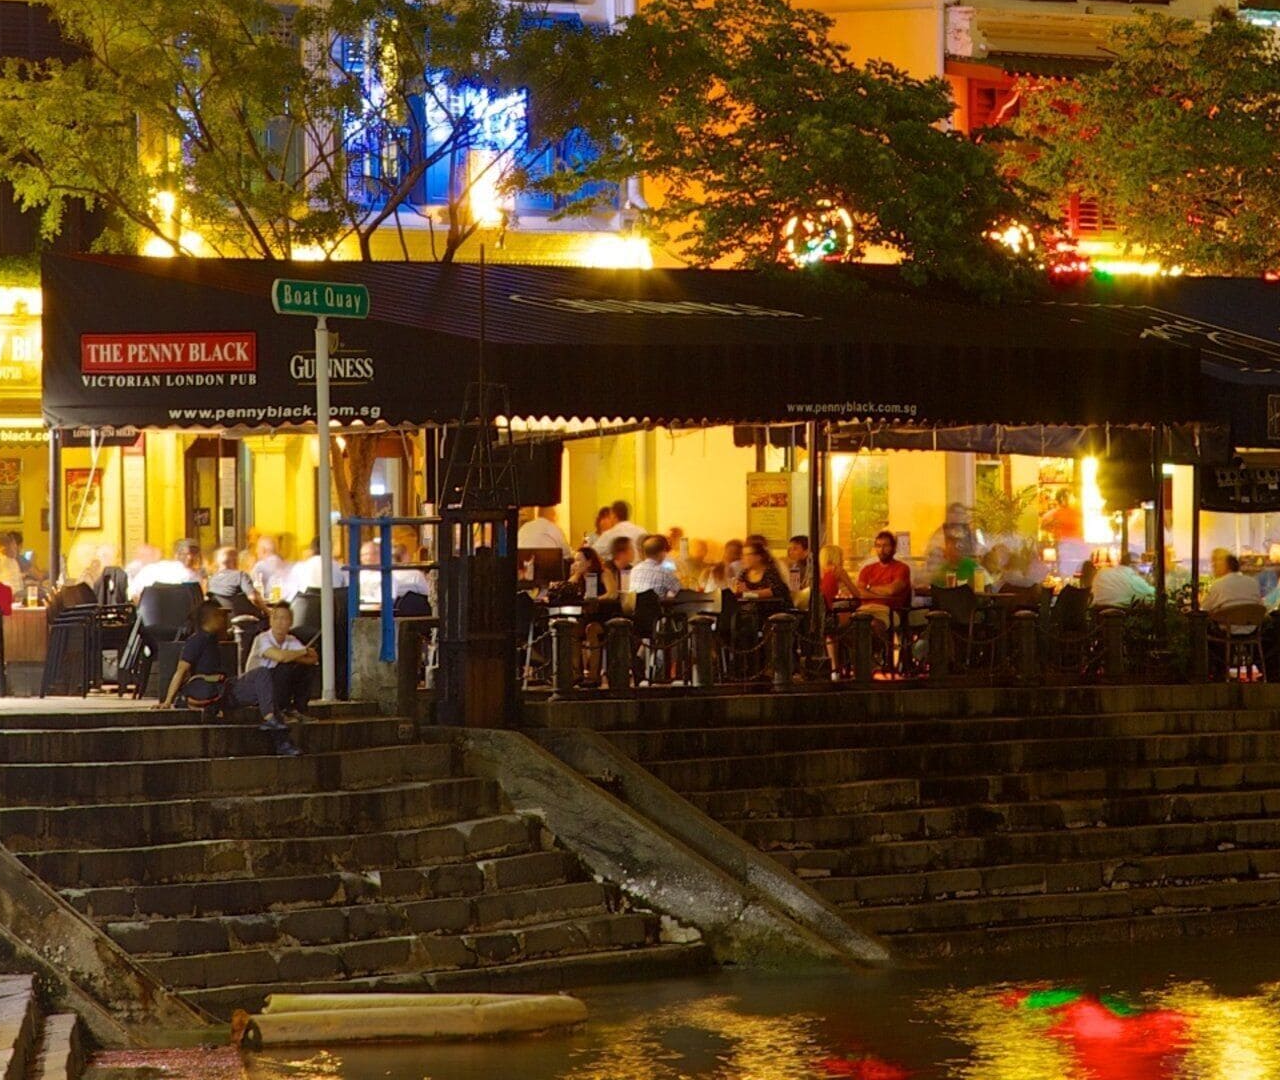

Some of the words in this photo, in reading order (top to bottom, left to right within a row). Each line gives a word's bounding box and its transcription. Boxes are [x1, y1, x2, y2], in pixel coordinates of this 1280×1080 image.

[283, 284, 319, 306] Boat
[324, 286, 361, 313] Quay
[87, 343, 123, 363] THE
[127, 342, 185, 363] PENNY
[188, 341, 249, 362] BLACK
[289, 354, 374, 379] GUNNESS
[81, 375, 161, 387] VICTORIAN
[166, 374, 224, 386] LONDON
[229, 373, 257, 385] PUB
[168, 404, 381, 421] www.pennyblack.om.sg
[786, 400, 917, 416] www.pennyblack.com.sg
